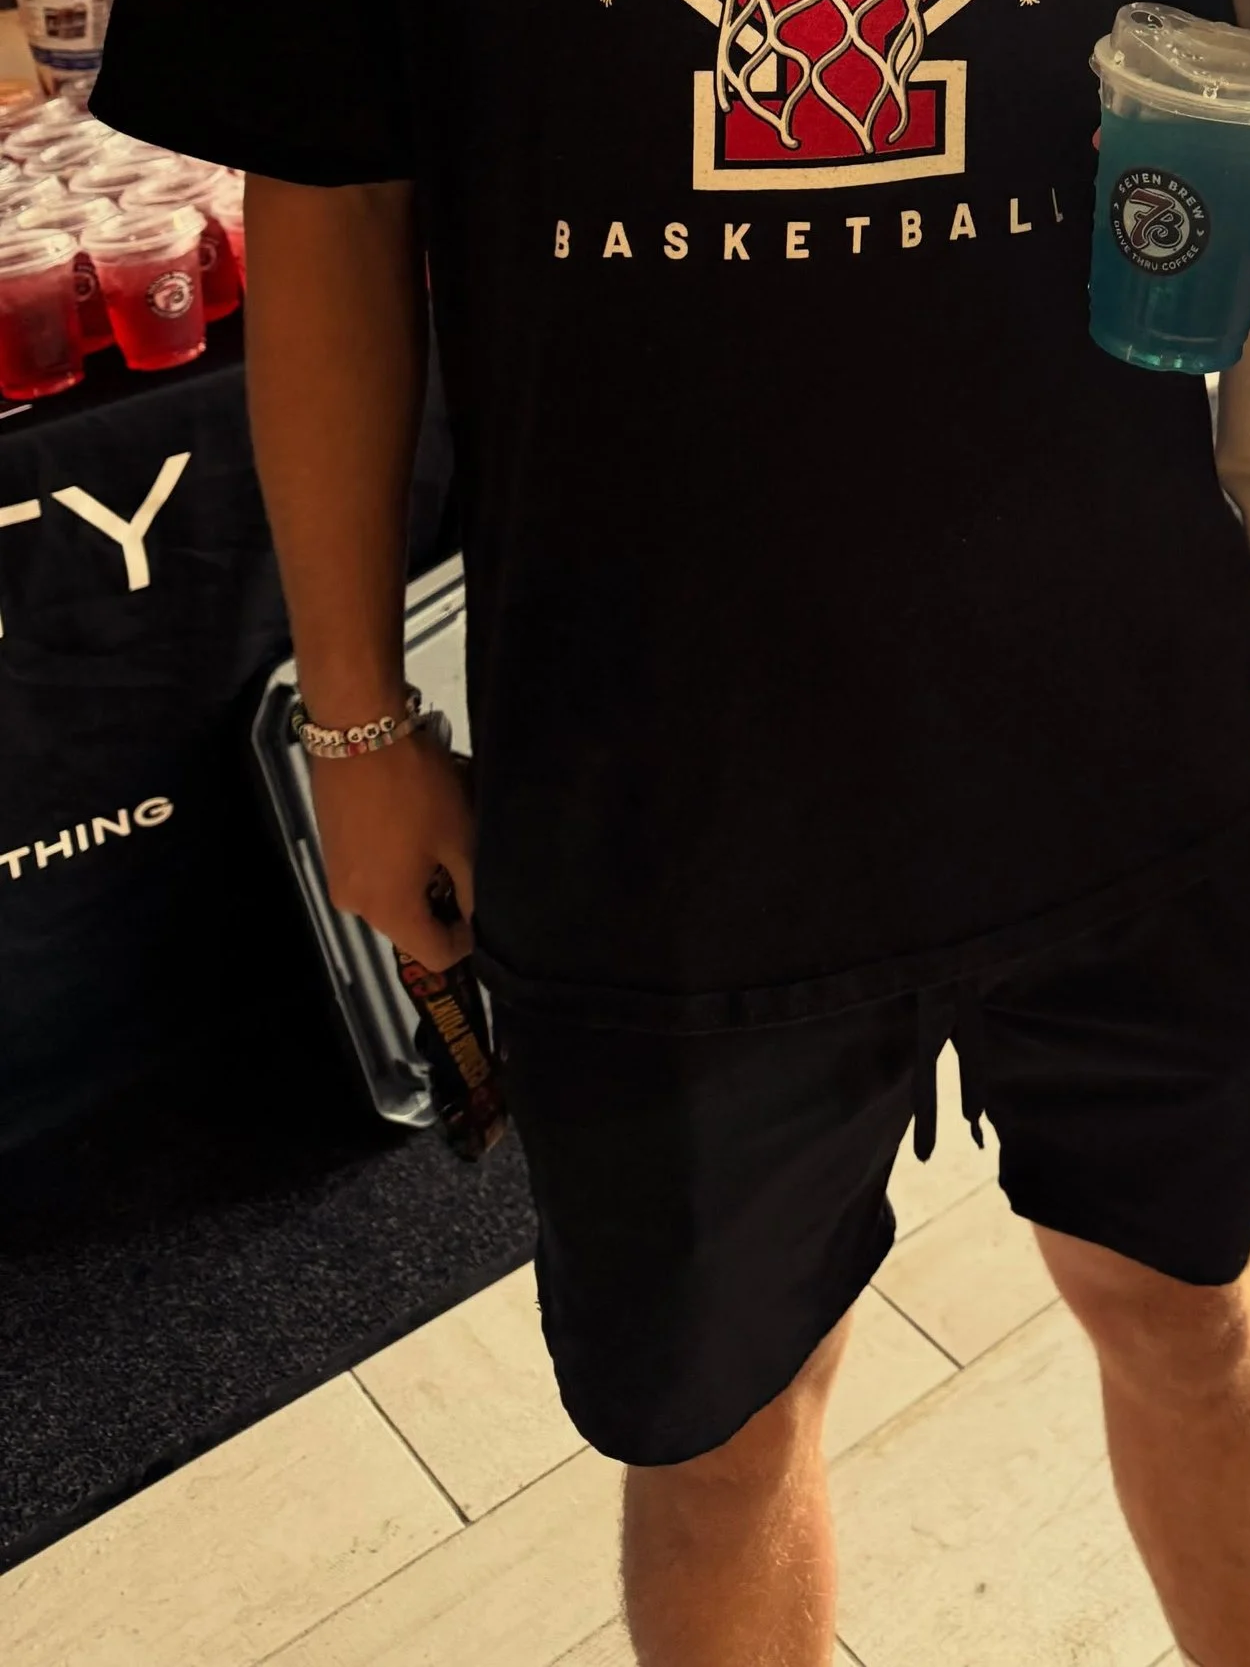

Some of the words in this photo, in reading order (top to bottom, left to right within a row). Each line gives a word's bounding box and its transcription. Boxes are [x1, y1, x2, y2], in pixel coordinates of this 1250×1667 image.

[1118, 172, 1161, 194] SEVEN
[1168, 180, 1205, 220] BREW
[1113, 220, 1132, 254] DRIVE
[1131, 252, 1158, 271] THRU
[1161, 244, 1200, 271] COFFEE
